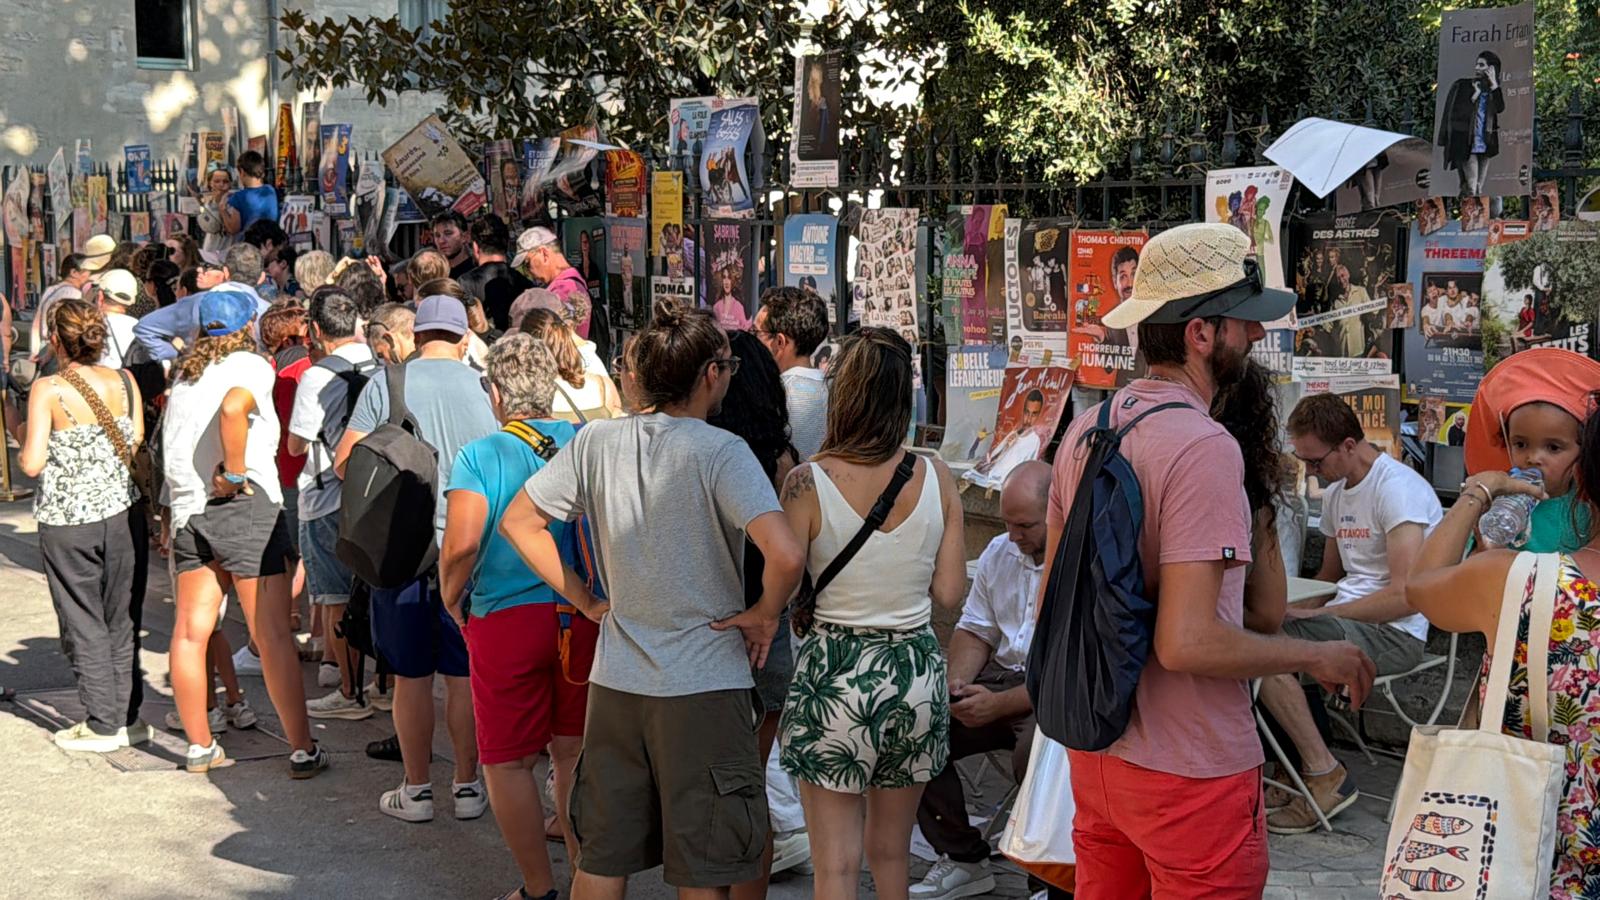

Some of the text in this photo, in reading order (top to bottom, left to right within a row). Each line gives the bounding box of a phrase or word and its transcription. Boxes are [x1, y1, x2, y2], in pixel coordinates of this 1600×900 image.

[1452, 24, 1500, 43] Farah
[1313, 228, 1379, 239] DES ASTRES
[1077, 236, 1143, 245] THOMAS CHRISTIN
[1007, 225, 1022, 330] LUCIOLES
[1570, 324, 1588, 336] LES
[1078, 342, 1120, 354] L'HORREUR
[950, 353, 989, 369] ISABELLE
[1363, 395, 1385, 410] MOI
